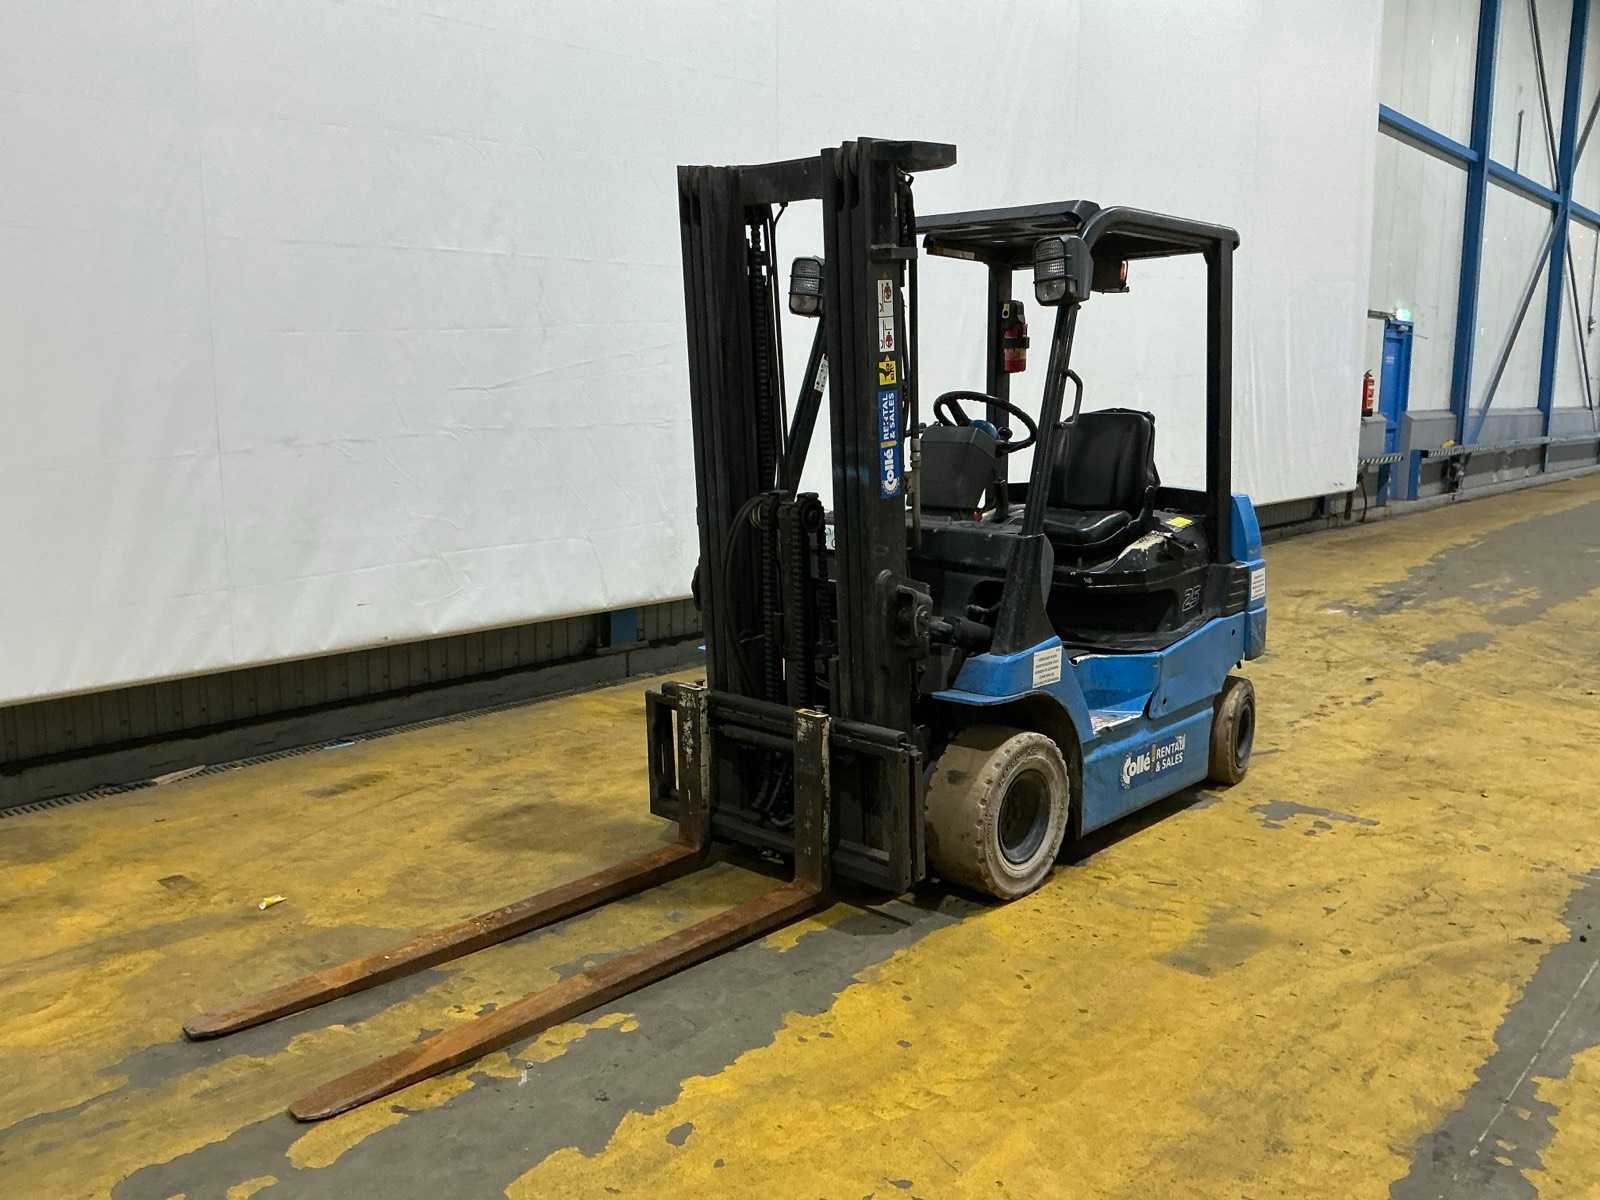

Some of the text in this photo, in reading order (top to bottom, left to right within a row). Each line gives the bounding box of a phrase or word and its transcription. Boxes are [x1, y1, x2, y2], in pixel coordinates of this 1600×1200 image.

[889, 431, 895, 440] &
[884, 447, 897, 492] Collé
[1122, 751, 1151, 785] Collé
[1155, 752, 1184, 773] & SALES
